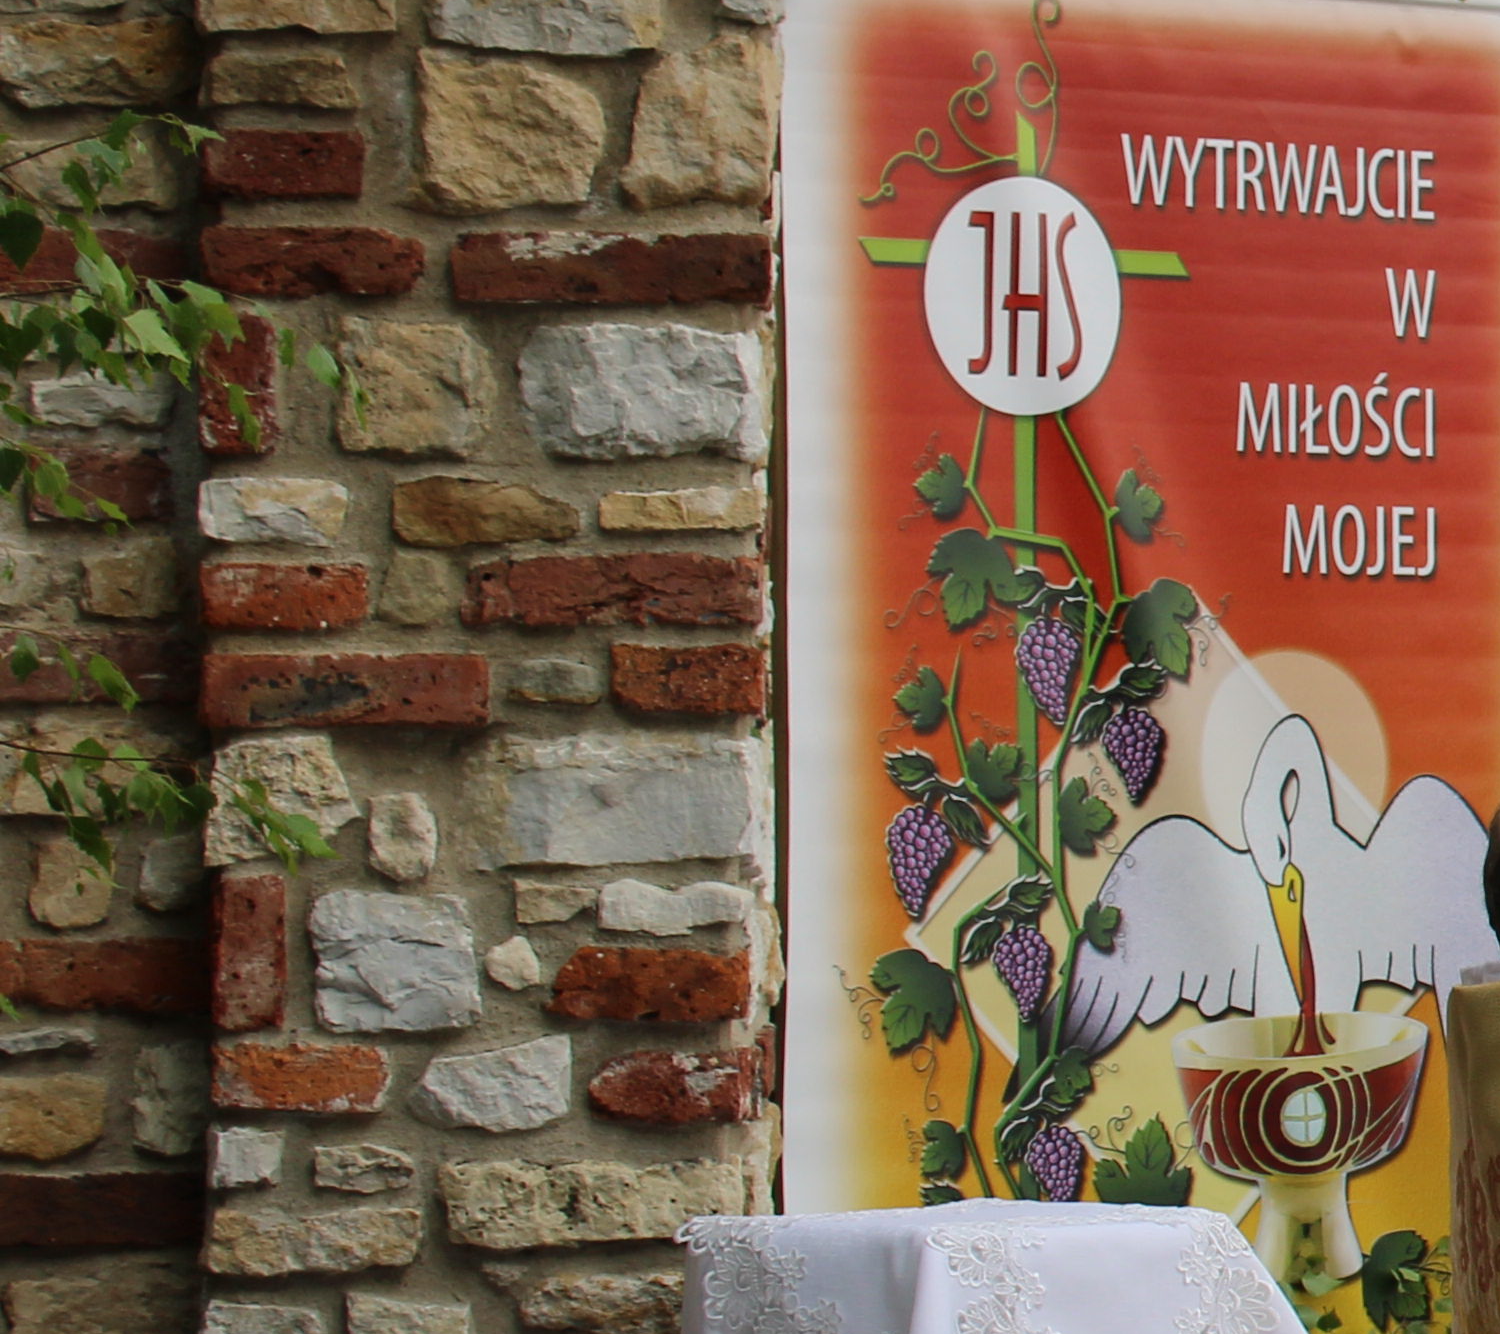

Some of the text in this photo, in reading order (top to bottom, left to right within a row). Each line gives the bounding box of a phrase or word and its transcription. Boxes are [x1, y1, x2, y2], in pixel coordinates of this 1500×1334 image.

[1120, 132, 1436, 222] WYTRWAJCIE
[1385, 268, 1436, 340] W
[1235, 372, 1436, 458] MIŁOŚCI
[1281, 503, 1437, 578] MOJEJ
